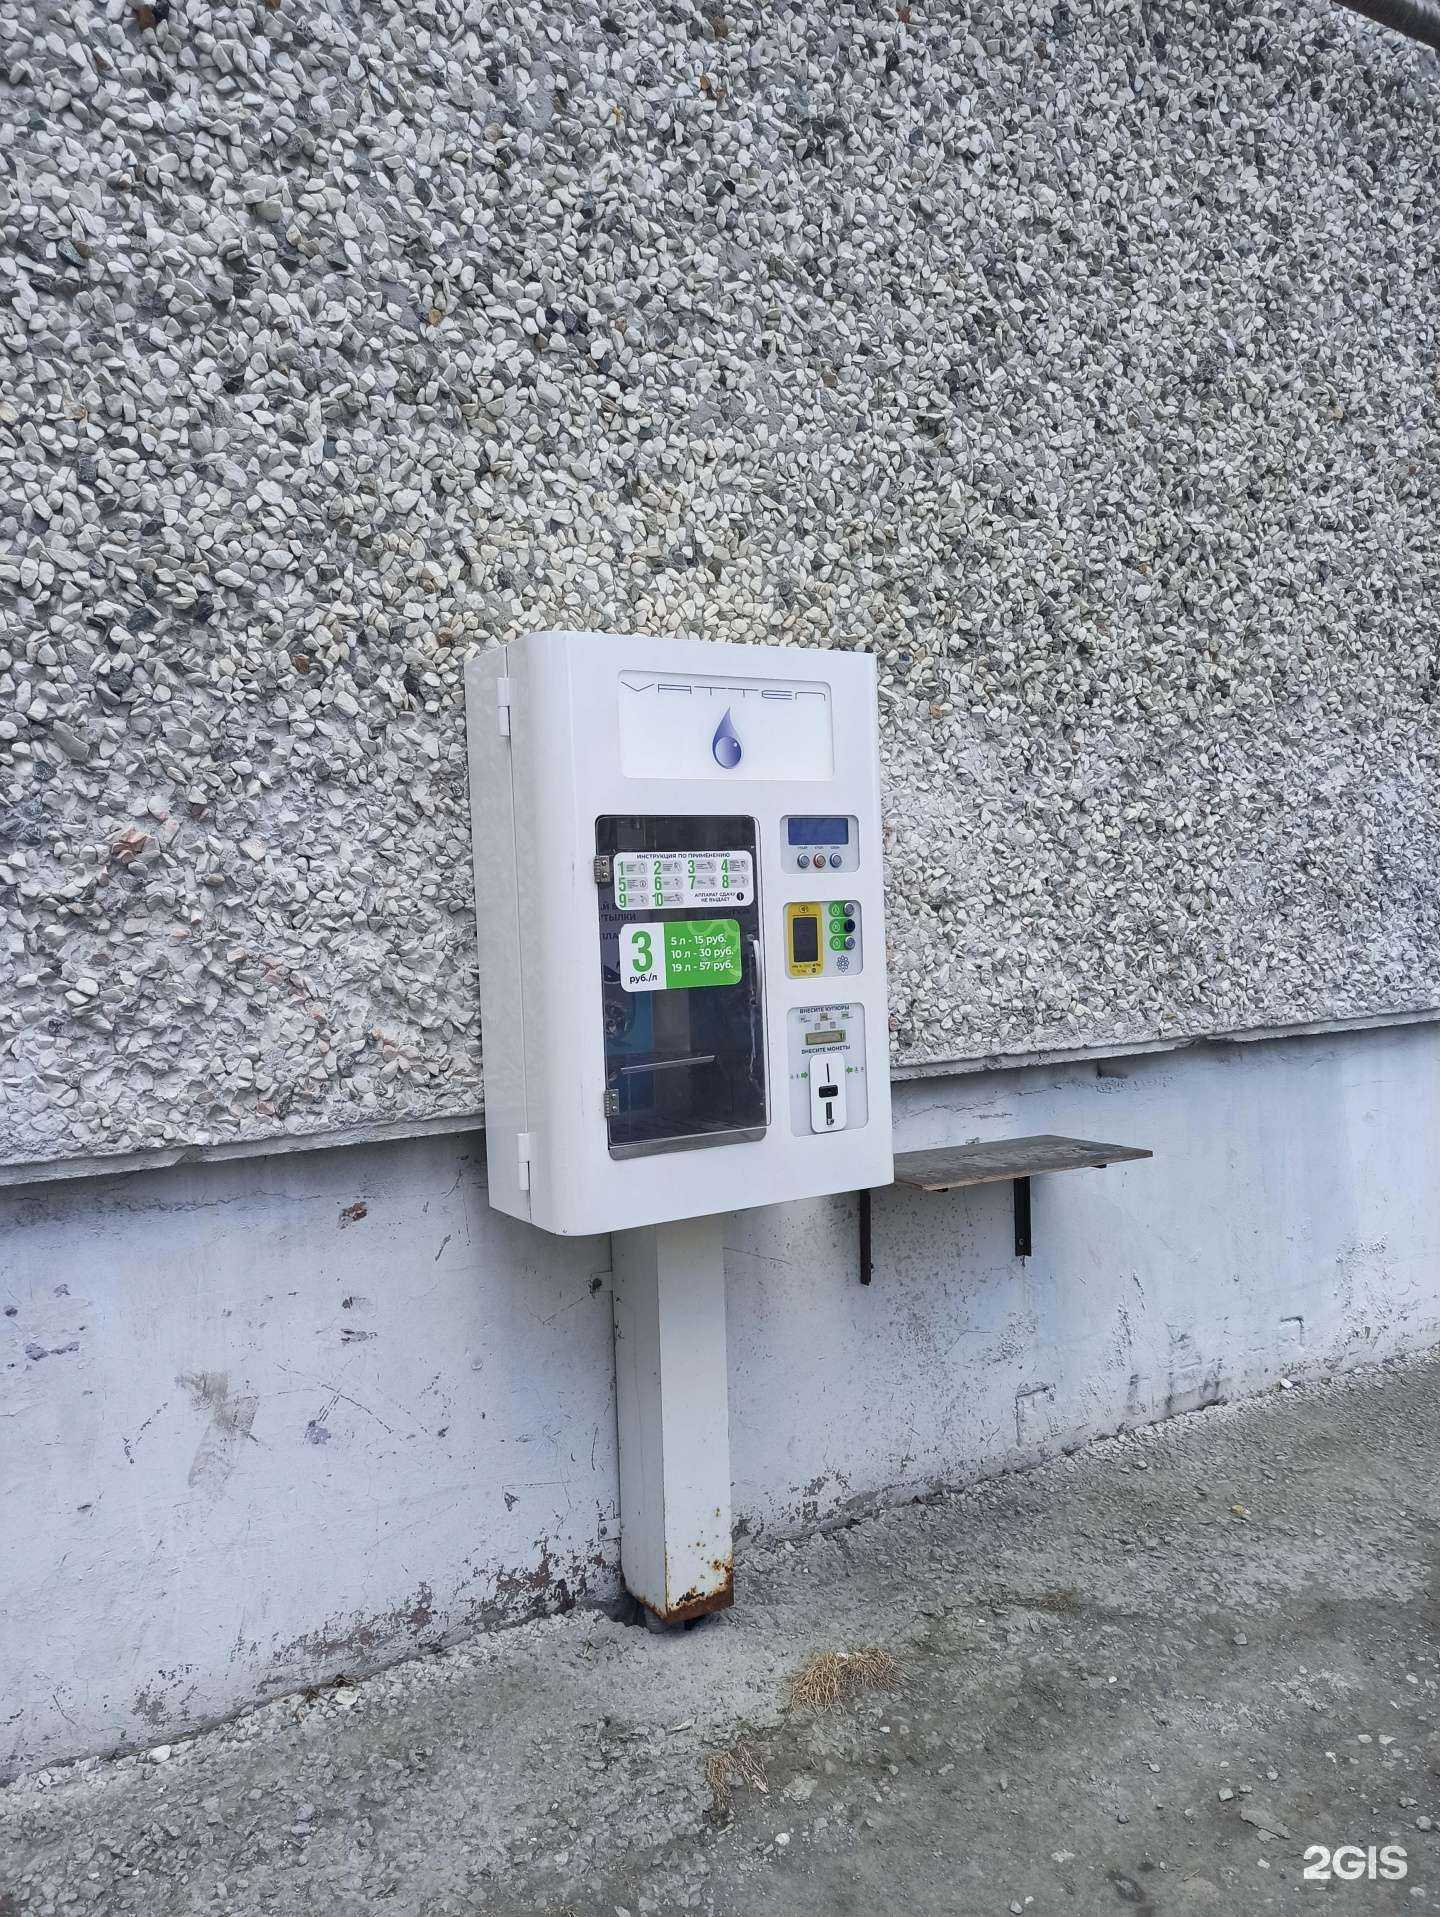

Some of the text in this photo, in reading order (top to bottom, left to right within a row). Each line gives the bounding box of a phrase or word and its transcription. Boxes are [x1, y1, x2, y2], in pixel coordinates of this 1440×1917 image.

[617, 861, 625, 876] 1
[653, 860, 662, 875] 2
[688, 859, 696, 874] 3
[721, 859, 729, 873] 4
[618, 877, 626, 892] 5
[655, 876, 662, 890] 6
[688, 875, 696, 889] 7
[721, 874, 730, 888] 8
[618, 893, 627, 908] 9
[652, 892, 664, 906] 10
[601, 913, 636, 921] ТЫЛКИ
[671, 936, 677, 945] 5
[694, 936, 704, 944] 15
[706, 933, 727, 946] руб.
[631, 930, 653, 972] 3
[671, 950, 682, 959] 10
[700, 949, 711, 957] 30
[714, 946, 734, 958] руб.
[672, 963, 682, 972] 19
[700, 962, 712, 970] 57
[713, 959, 734, 972] руб.
[629, 972, 658, 984] руб./л
[800, 1006, 824, 1014] ВНЕСИТЕ
